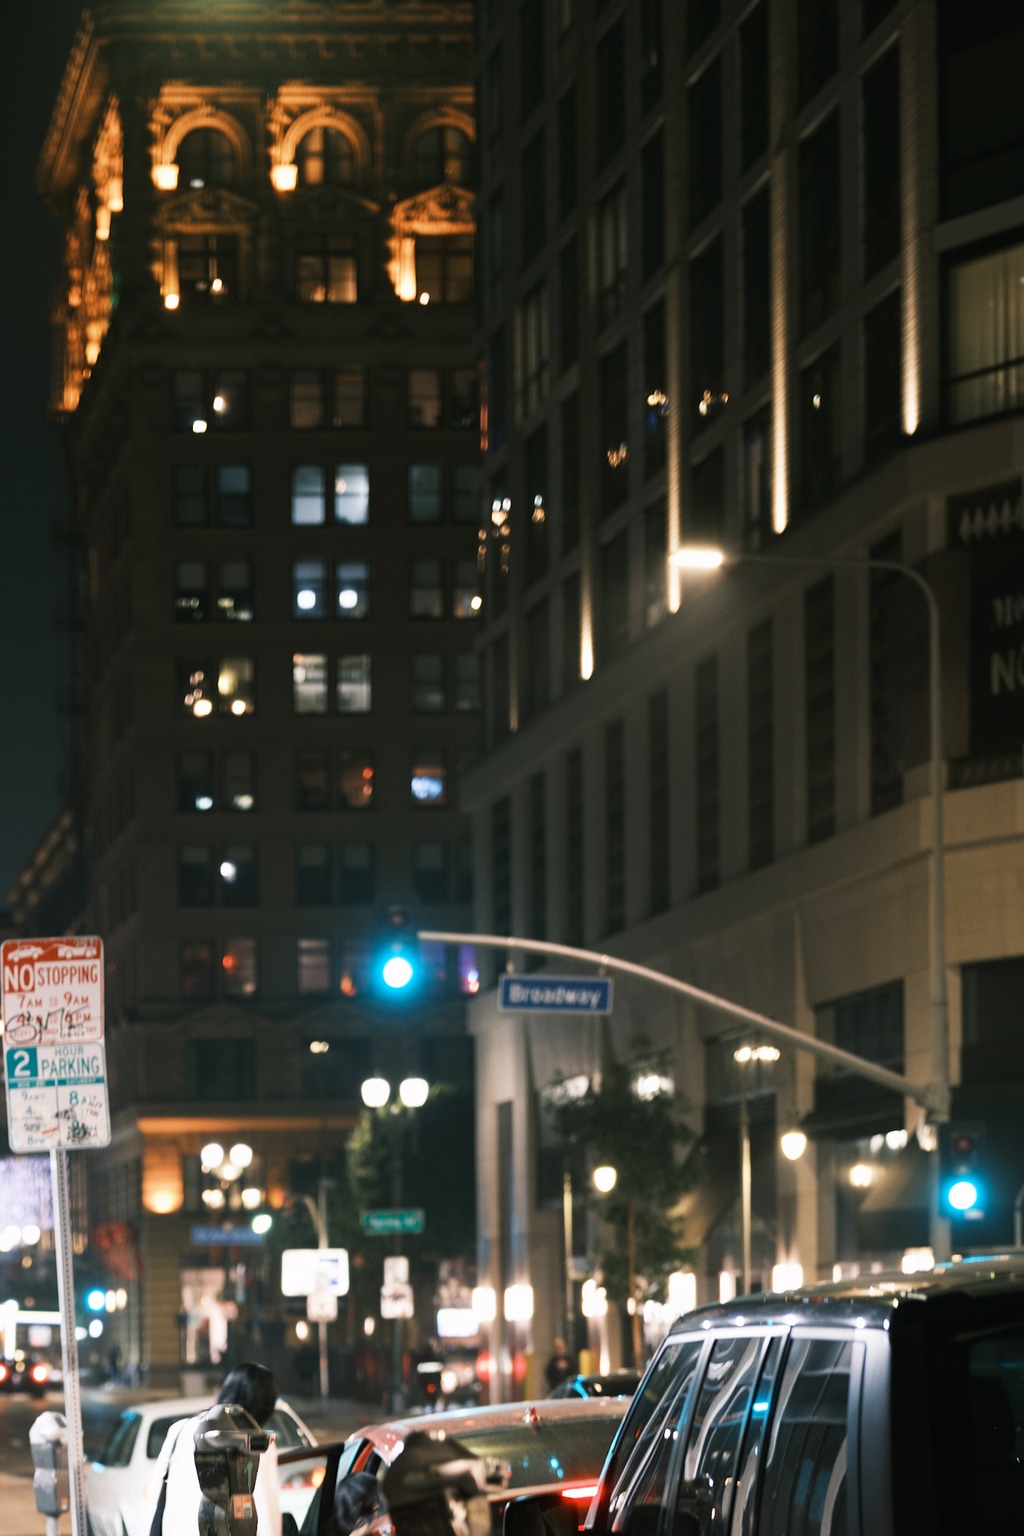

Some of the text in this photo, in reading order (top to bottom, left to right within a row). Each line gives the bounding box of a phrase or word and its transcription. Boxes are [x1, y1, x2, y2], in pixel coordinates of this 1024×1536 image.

[4, 963, 98, 993] NO STOPPING
[509, 983, 602, 1010] Broadway
[13, 1045, 84, 1077] 2 HOUR
[41, 1055, 100, 1077] PARKING
